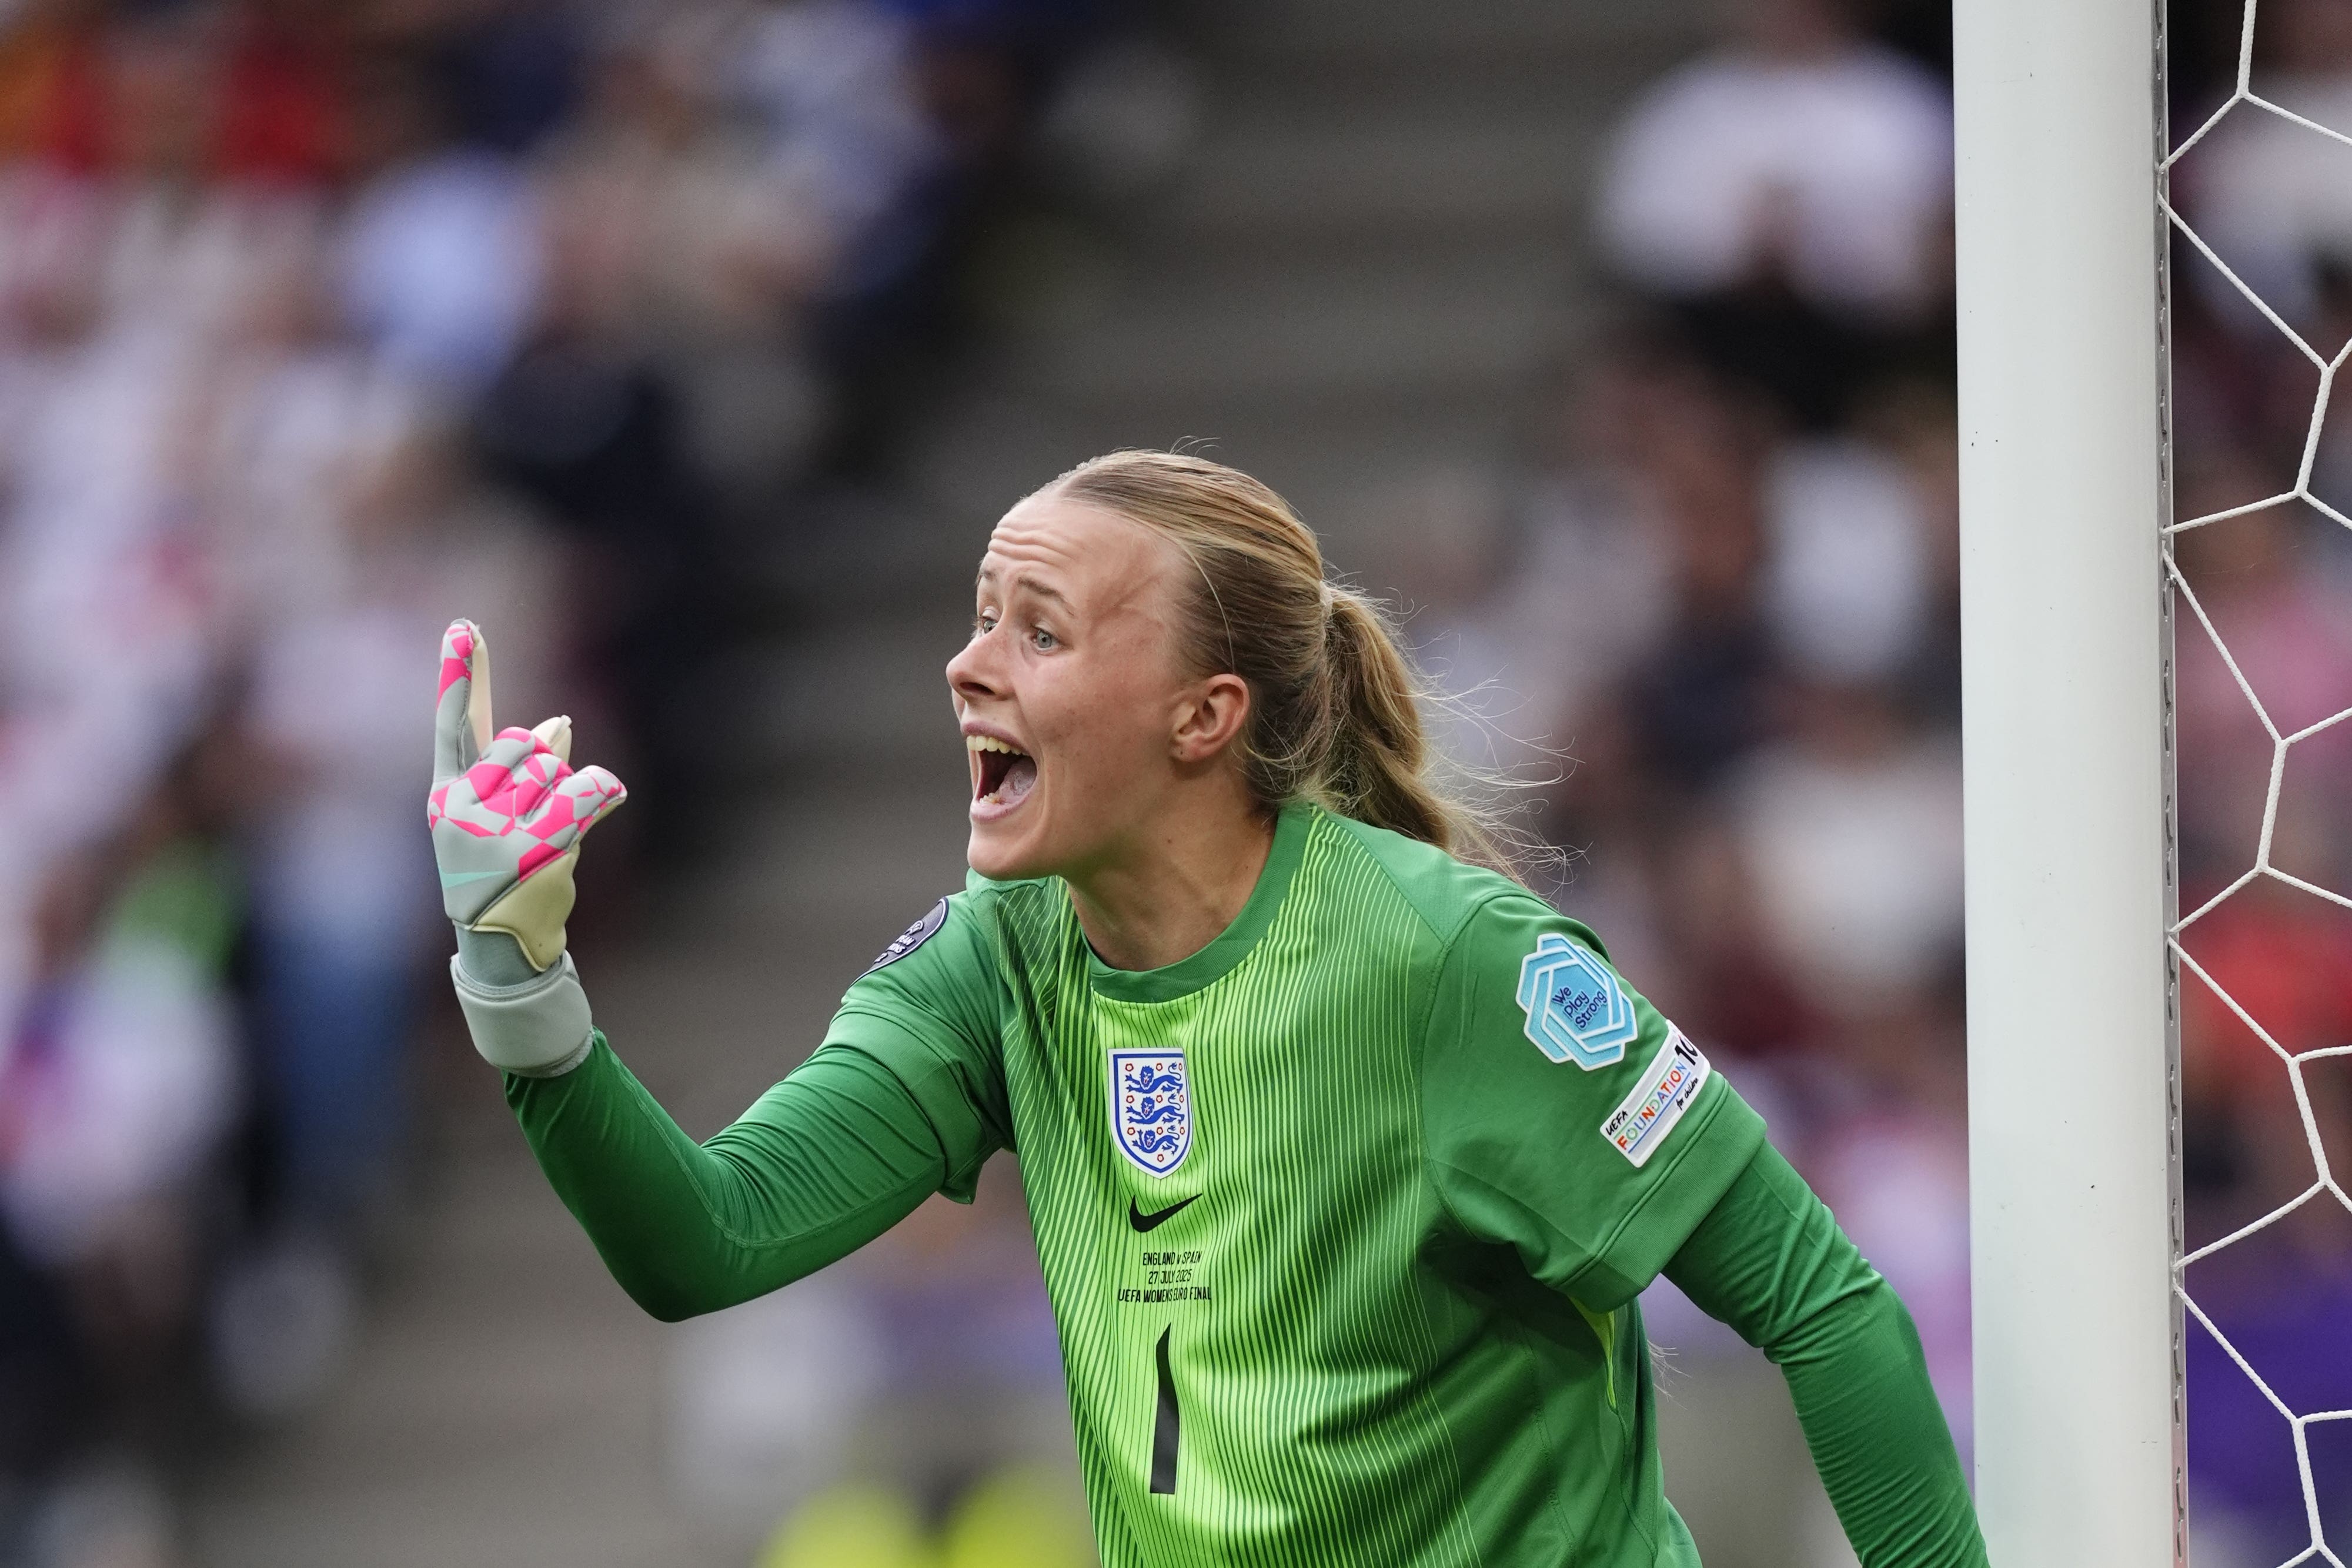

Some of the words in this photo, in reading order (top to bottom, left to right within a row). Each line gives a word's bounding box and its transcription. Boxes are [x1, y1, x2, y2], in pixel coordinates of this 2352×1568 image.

[1552, 987, 1572, 1004] We
[1564, 991, 1590, 1018] Play
[1575, 991, 1607, 1028] Strong
[1676, 1098, 1685, 1111] for
[1606, 1110, 1628, 1135] UEFA
[1143, 1252, 1175, 1265] ENGLAND
[1182, 1251, 1202, 1264] SPAIN
[1148, 1271, 1158, 1284] 27
[1160, 1270, 1176, 1284] JULY
[1176, 1269, 1192, 1282] 2025
[1118, 1288, 1141, 1302] UEFA
[1173, 1287, 1188, 1301] EURO
[1190, 1286, 1212, 1300] FINAL
[1150, 1321, 1180, 1495] 1
